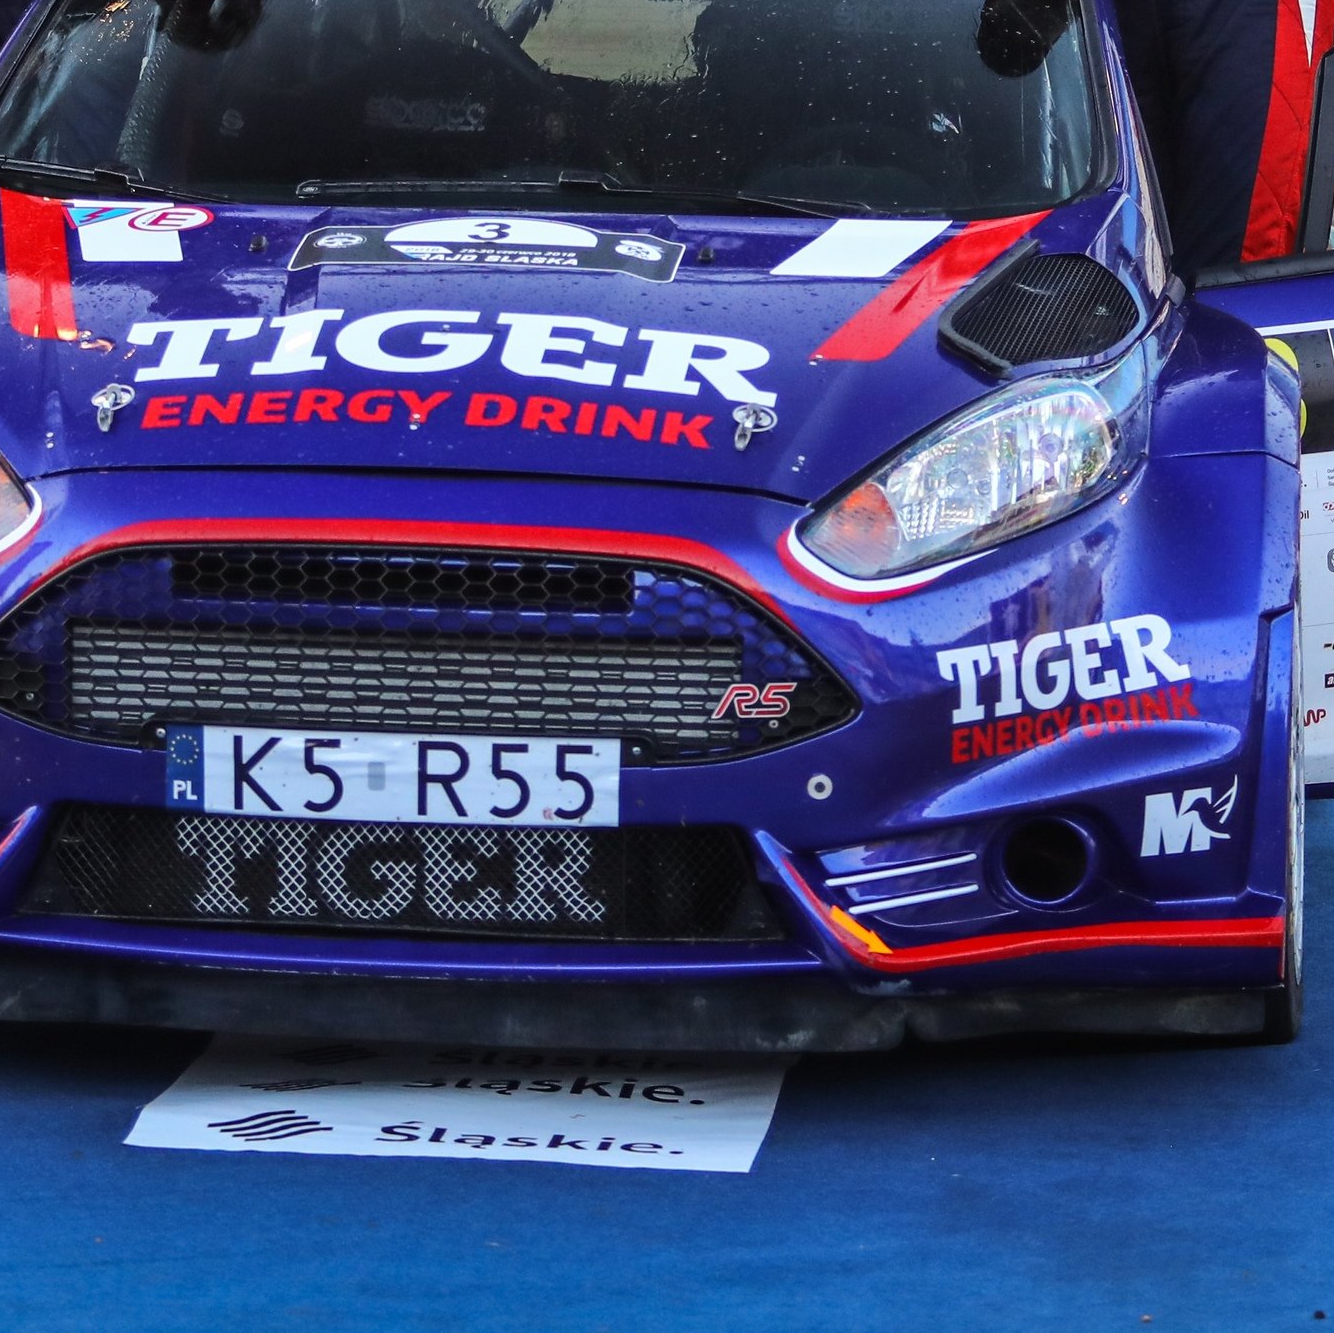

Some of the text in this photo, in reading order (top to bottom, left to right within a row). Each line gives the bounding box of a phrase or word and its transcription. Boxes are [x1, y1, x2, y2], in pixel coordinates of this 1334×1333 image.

[468, 222, 513, 241] 3
[128, 309, 778, 408] TIGER
[141, 390, 715, 450] ENERGY DRINK
[936, 613, 1191, 725] TIGER
[951, 683, 1199, 764] ENERGY DRINK
[172, 780, 198, 801] PL
[232, 735, 596, 820] K5 R55
[176, 814, 606, 923] TIGER
[375, 1120, 685, 1156] Śląskie.
